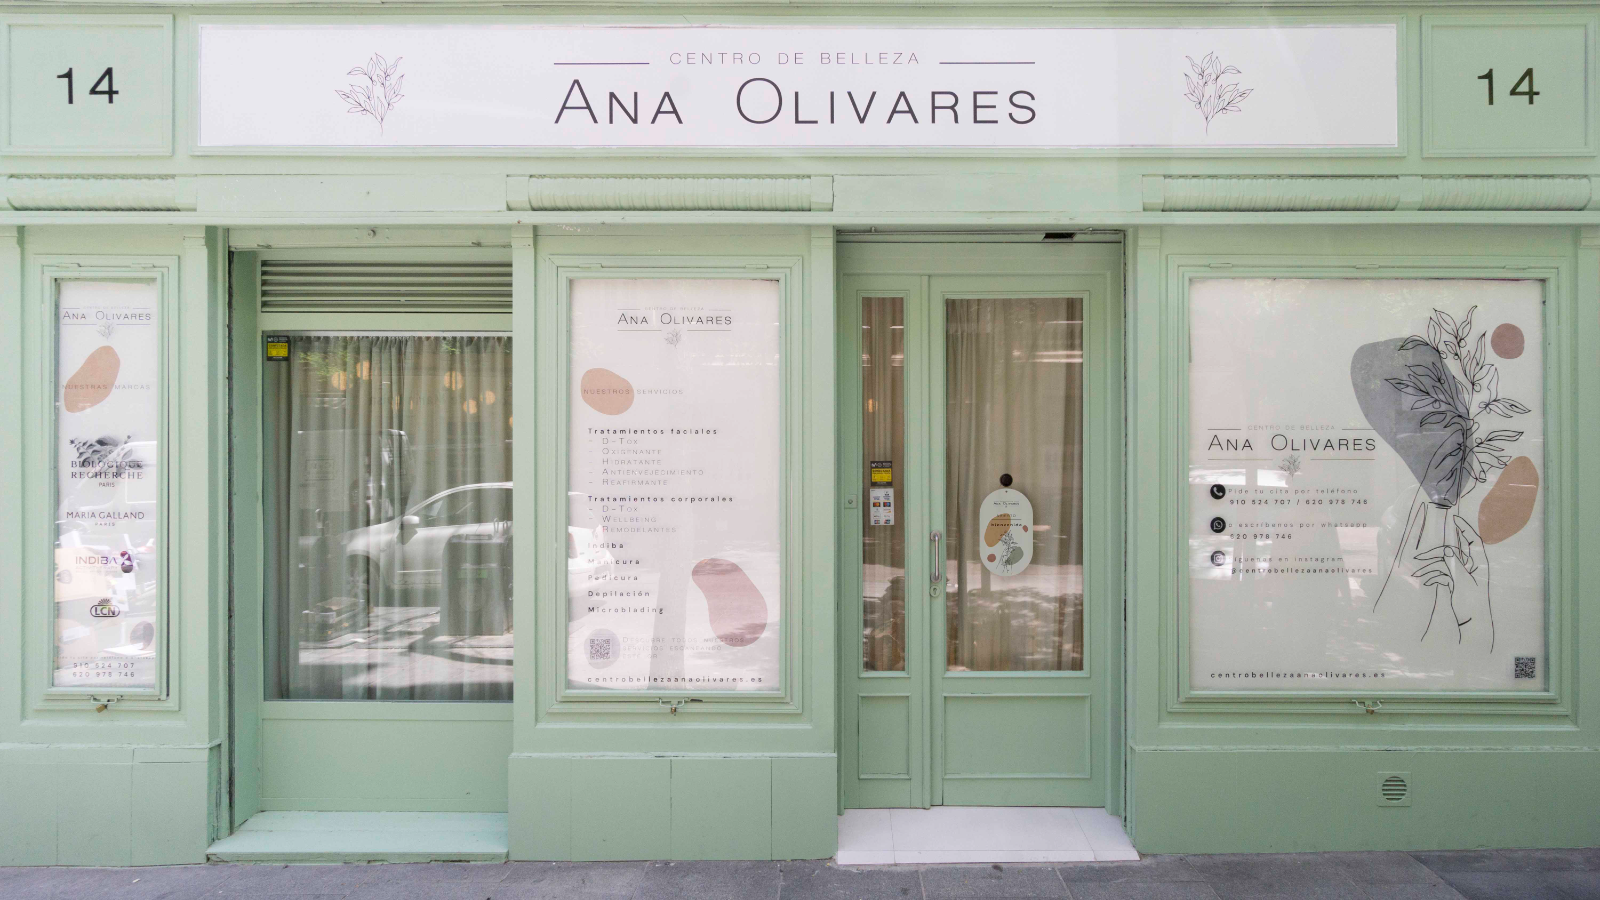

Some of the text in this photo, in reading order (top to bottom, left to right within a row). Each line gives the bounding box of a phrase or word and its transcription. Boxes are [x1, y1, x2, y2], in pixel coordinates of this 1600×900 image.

[669, 52, 919, 65] CENTRO DE BELLEZA
[57, 67, 119, 104] 14
[1477, 68, 1540, 105] 14
[554, 77, 1036, 125] ANA OLIVARES
[62, 310, 152, 321] ANA OLIVARES
[617, 312, 732, 325] ANA OLIVARES
[1207, 433, 1376, 451] ANA OLIVARES
[71, 460, 143, 470] BIOLOGIQUE
[71, 471, 144, 479] RECHERCHE
[670, 495, 734, 503] corporales
[66, 511, 145, 519] MARIA GALLAND
[75, 556, 118, 565] INDIBA
[588, 590, 651, 599] Depilación
[94, 606, 116, 615] LCN
[588, 607, 664, 615] Microblading
[1210, 671, 1386, 679] centrobellezaanaolivares.es
